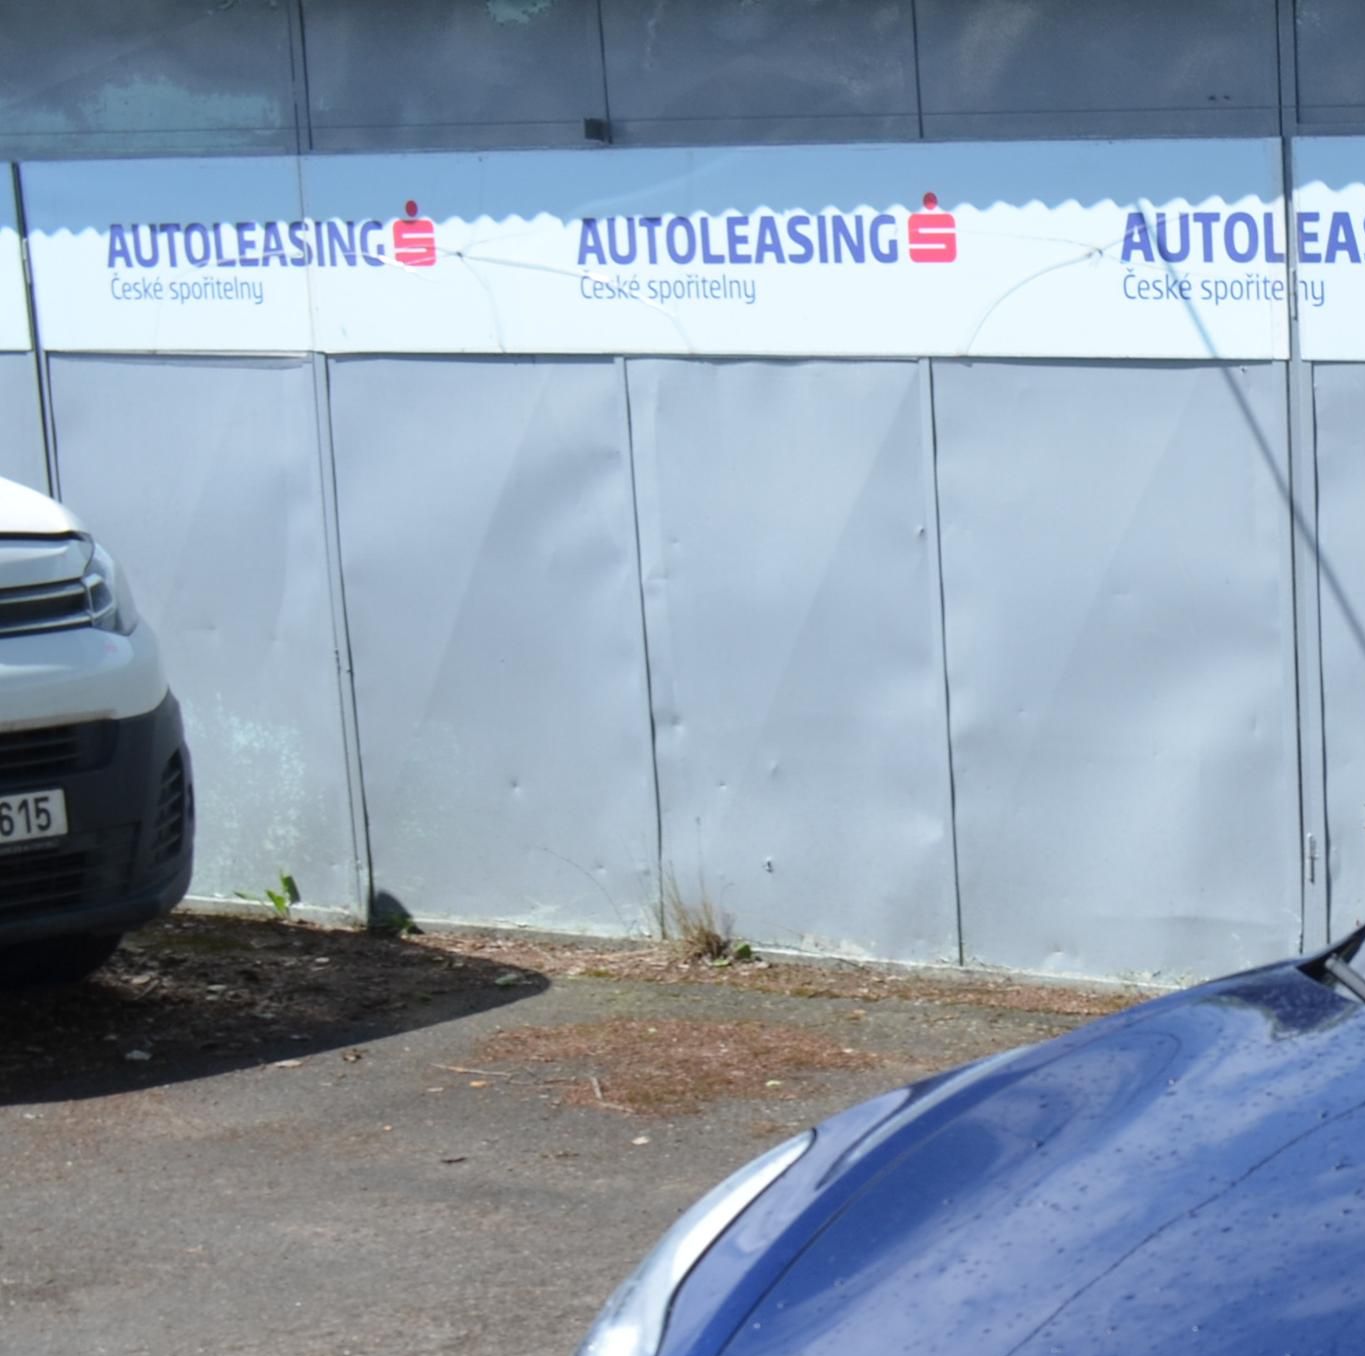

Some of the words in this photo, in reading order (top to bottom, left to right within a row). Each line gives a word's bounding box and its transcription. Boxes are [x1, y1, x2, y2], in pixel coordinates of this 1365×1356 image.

[107, 220, 385, 268] AUTOLEASING
[577, 214, 898, 265] AUTOLEASING
[111, 273, 163, 301] České
[169, 276, 264, 304] spořitelny
[580, 270, 640, 300] České
[648, 274, 756, 304] spořitelny
[1123, 268, 1192, 301] České
[1200, 272, 1325, 306] spořiteny
[0, 797, 51, 836] 615
